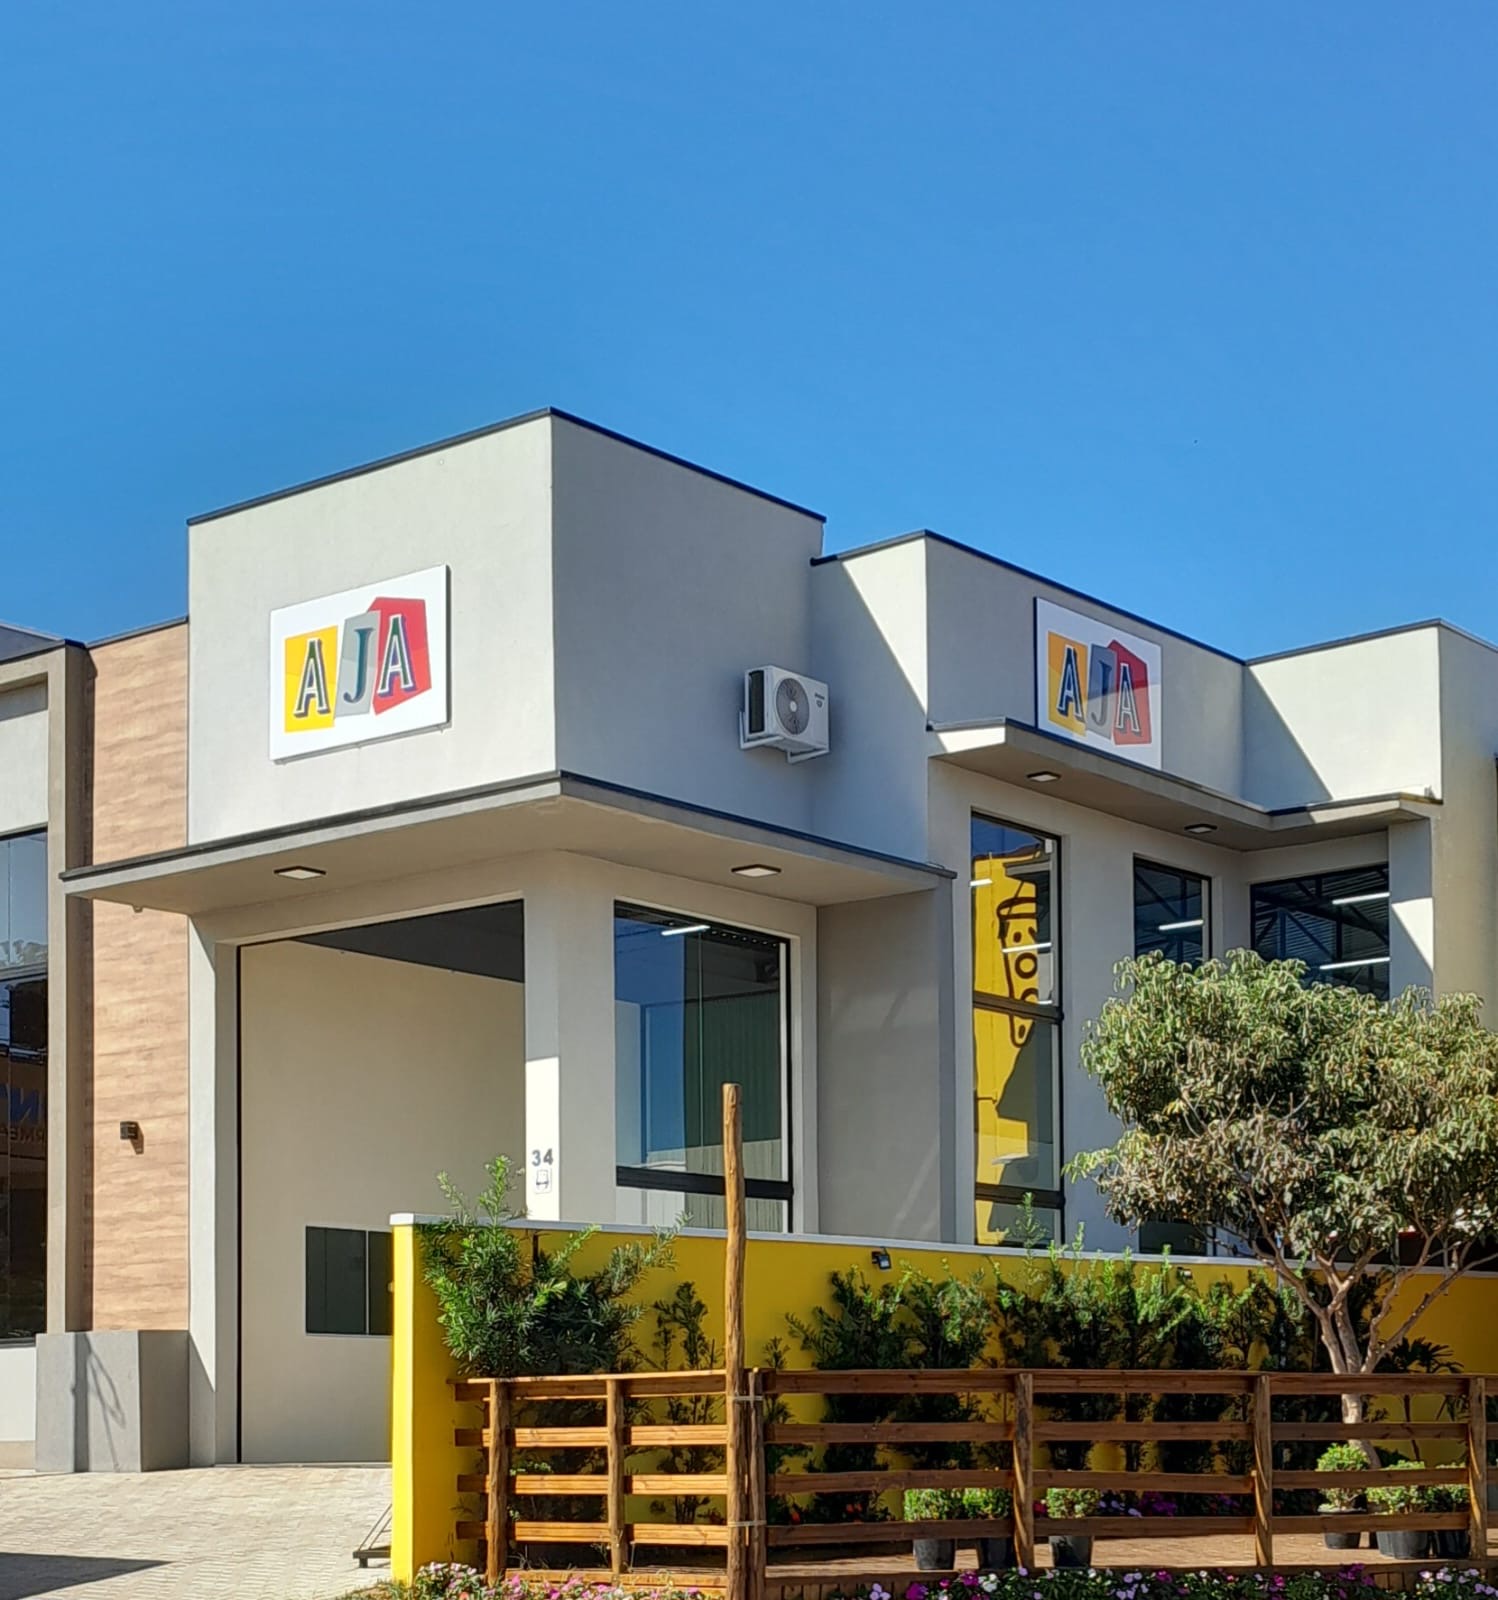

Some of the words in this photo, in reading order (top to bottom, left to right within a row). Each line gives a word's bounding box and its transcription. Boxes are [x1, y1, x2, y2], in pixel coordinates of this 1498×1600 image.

[293, 613, 417, 718] AJA
[1056, 644, 1141, 735] AJA
[531, 1148, 553, 1167] 34
